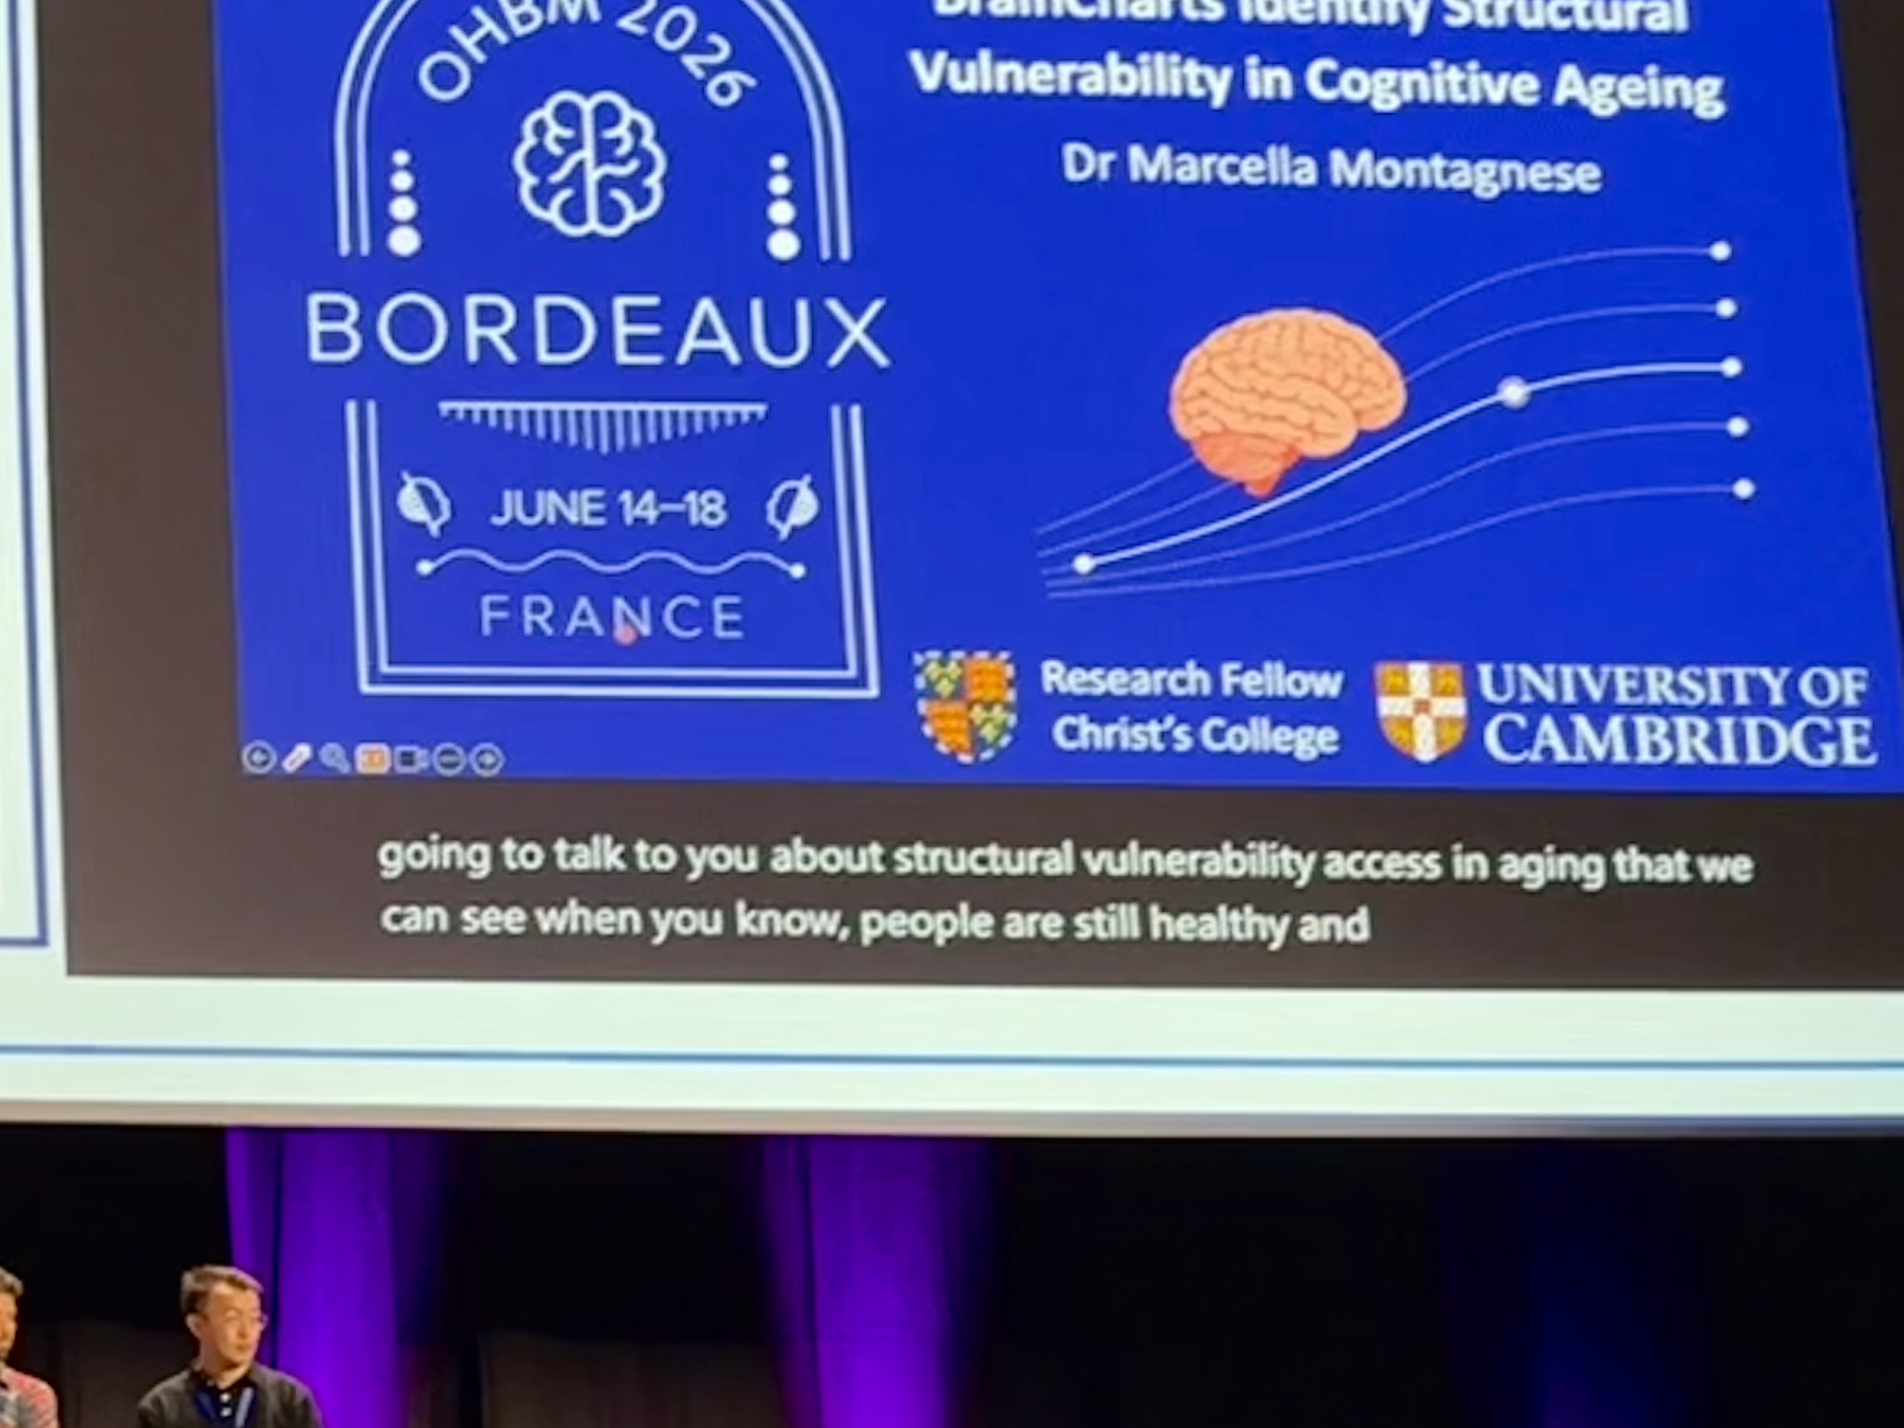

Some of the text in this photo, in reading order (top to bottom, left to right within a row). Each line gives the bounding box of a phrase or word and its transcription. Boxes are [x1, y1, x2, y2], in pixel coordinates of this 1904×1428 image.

[909, 48, 1726, 120] Vulnerability in Cognitive Ageing
[1063, 142, 1602, 199] Dr Marcella Montagnese
[307, 292, 889, 367] BORDEAUX
[491, 489, 606, 525] JUNE
[481, 594, 743, 640] FRANCE
[1041, 659, 1343, 698] Research Fellow
[1477, 663, 1867, 707] UNIVERSITY OF
[1200, 716, 1339, 761] College
[1484, 712, 1877, 766] CAMBRIDGE
[378, 833, 1754, 891] going to talk to you about structural vulnerability access in aging that we
[381, 897, 1371, 952] can see when you know, people are still healthy and
